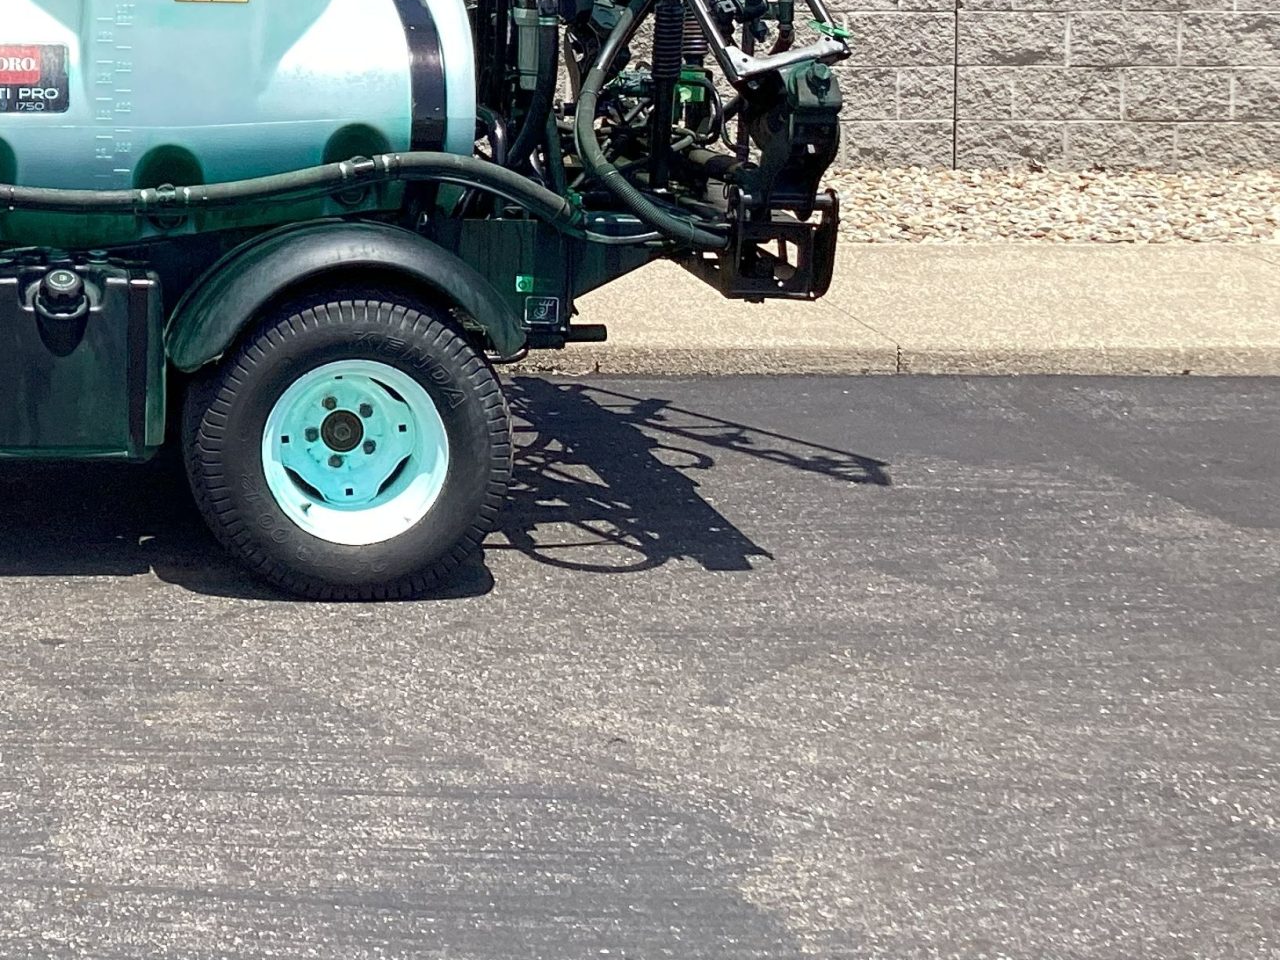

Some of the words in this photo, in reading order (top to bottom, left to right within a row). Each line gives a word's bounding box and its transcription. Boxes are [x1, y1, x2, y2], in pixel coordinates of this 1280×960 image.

[18, 87, 59, 100] PRO
[15, 101, 45, 111] 1750
[352, 330, 466, 409] KENDA
